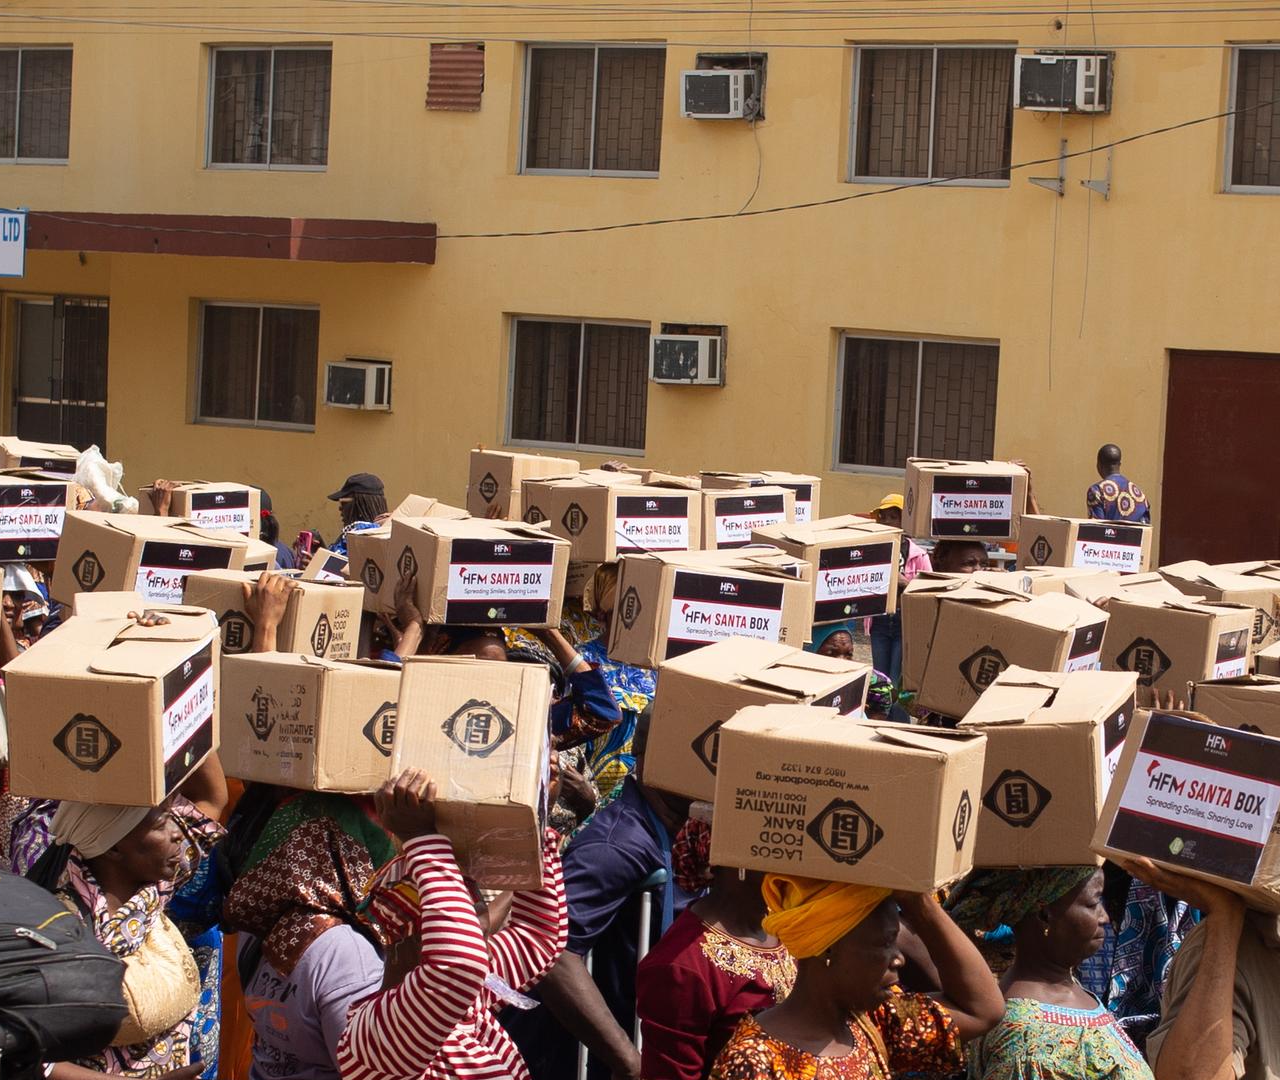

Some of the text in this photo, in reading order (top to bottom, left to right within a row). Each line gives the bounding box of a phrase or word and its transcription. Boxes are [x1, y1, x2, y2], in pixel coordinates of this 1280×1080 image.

[2, 217, 20, 242] LTD
[943, 500, 1005, 509] HFM SANTA BOX
[0, 513, 59, 526] HFM SANTA BOX
[626, 526, 682, 536] HFM SANTA BOX
[1084, 549, 1135, 561] HFM SANTA BOX
[148, 577, 170, 589] HFM
[463, 573, 542, 585] HFM SANTA BOX
[827, 571, 884, 588] HFM SANTA BOX
[685, 610, 770, 631] HFM SANTA BOX
[1205, 733, 1232, 751] HFM
[756, 772, 870, 791] www.lagosfoodbank.org
[736, 787, 807, 802] FOOD LIVE HOPE
[1148, 771, 1266, 816] HFM SANTA BOX
[735, 797, 806, 816] INITIATIVE
[1146, 796, 1254, 831] Spreading Smiles, Sharing Love
[763, 815, 805, 831] BANK
[759, 832, 804, 846] FOOD
[750, 844, 803, 861] LAGOS
